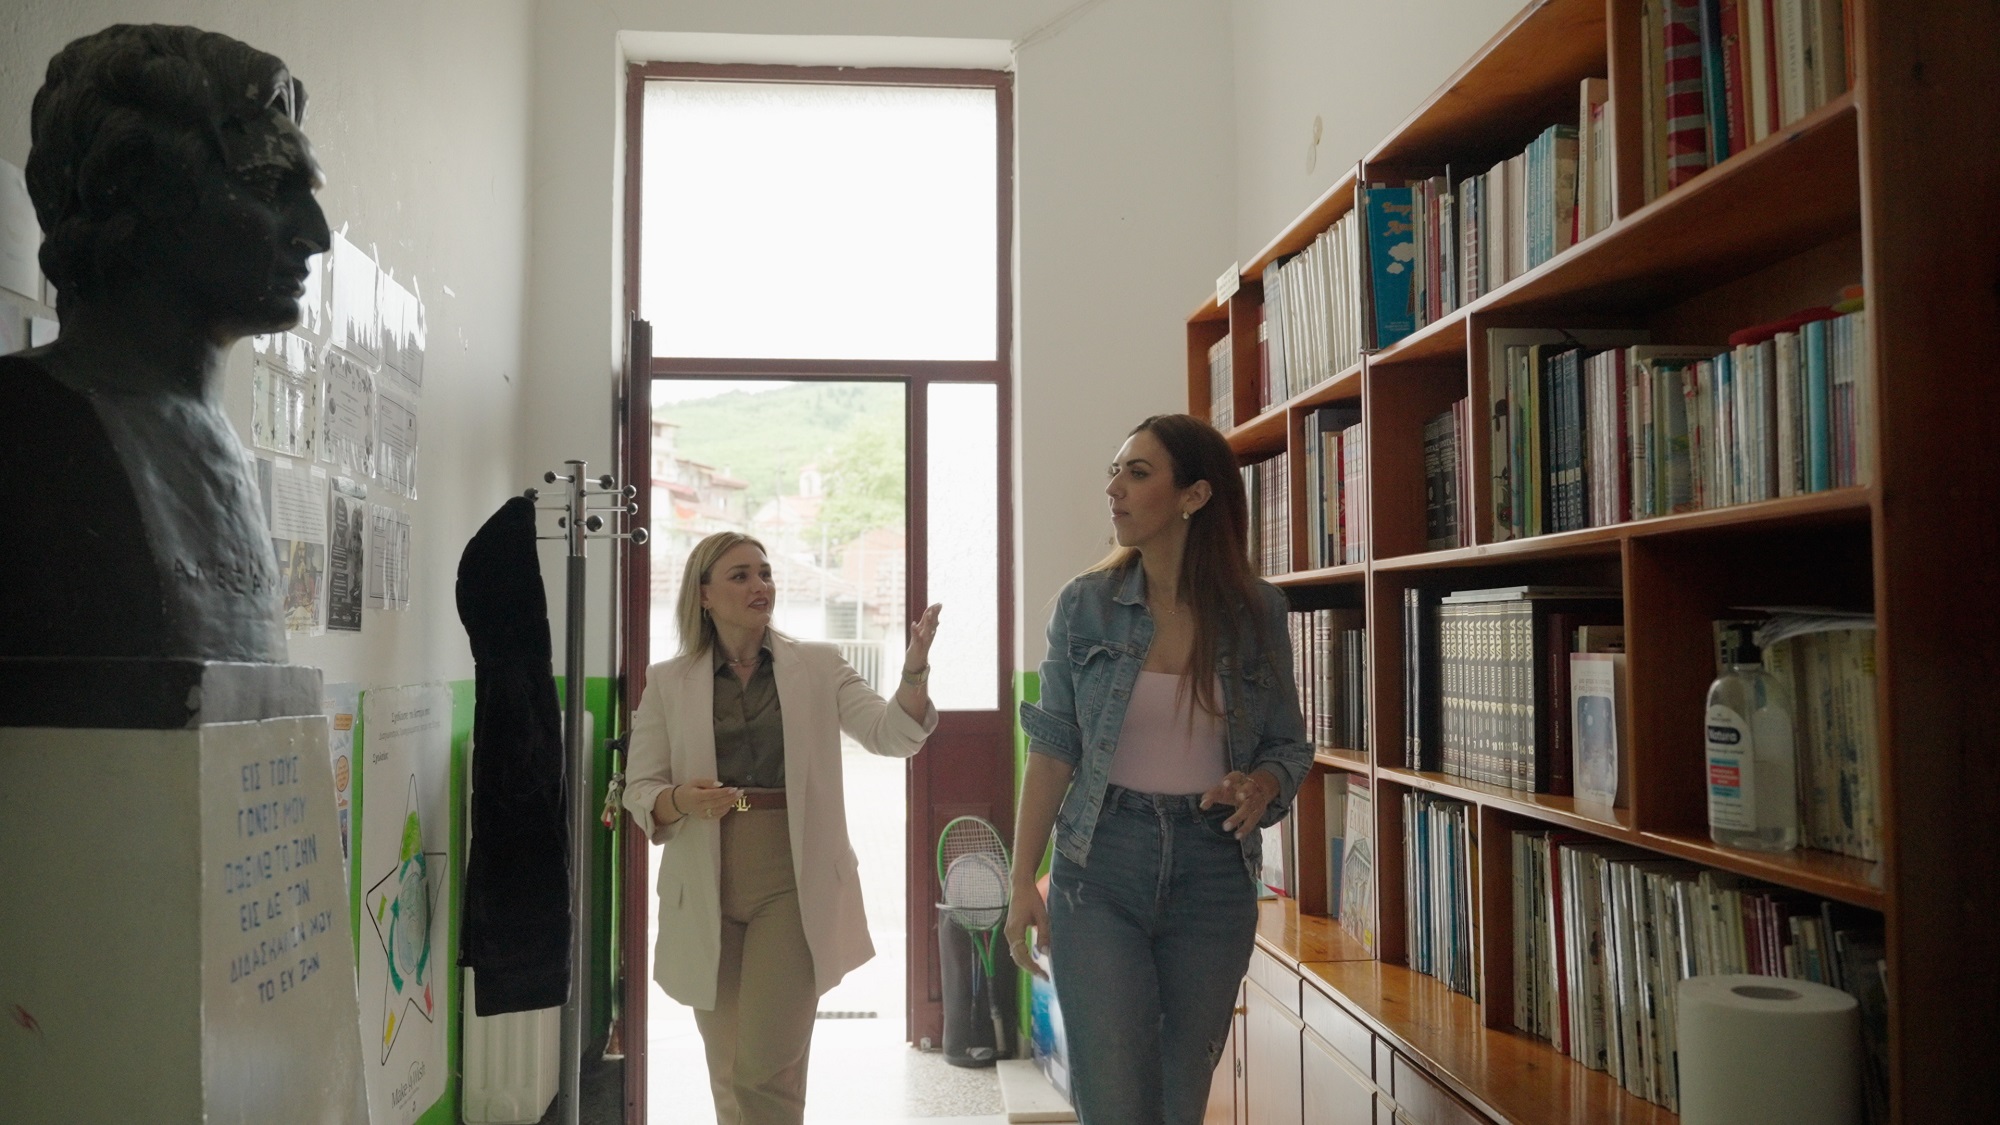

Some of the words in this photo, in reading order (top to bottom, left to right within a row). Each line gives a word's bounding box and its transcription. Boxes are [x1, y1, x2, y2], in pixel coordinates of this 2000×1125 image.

[241, 763, 261, 792] ΕΙΣ
[269, 756, 299, 787] ΤΟΥΣ
[292, 834, 318, 870] ΖΗΝ
[240, 901, 261, 932] ΕΙΣ
[267, 892, 282, 920] ΔΕ
[257, 978, 275, 1003] ΤΟ
[281, 966, 295, 993] ΕΥ
